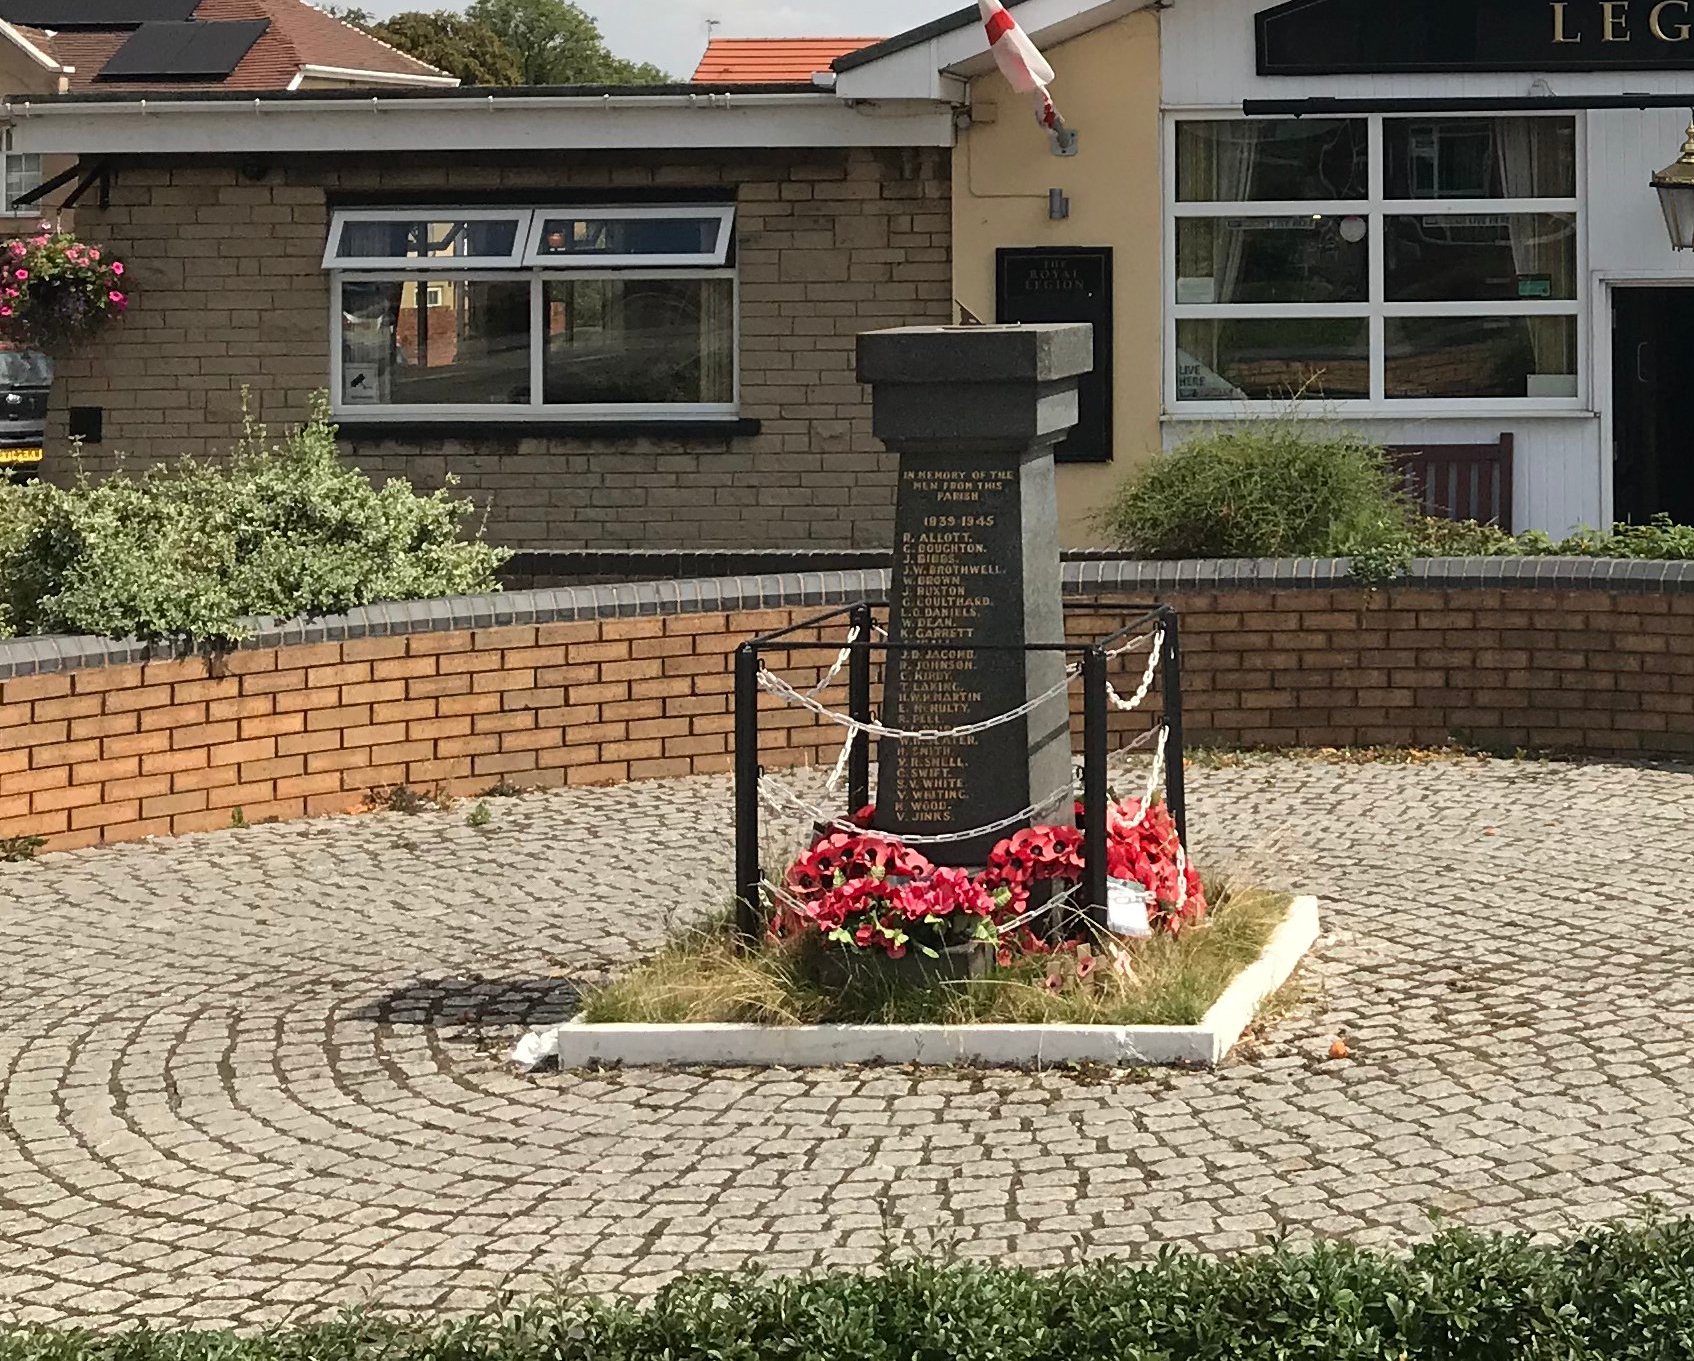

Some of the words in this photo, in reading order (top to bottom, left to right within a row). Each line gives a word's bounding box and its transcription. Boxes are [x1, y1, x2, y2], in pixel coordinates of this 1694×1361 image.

[903, 471, 915, 479] IN
[918, 471, 966, 479] MEMORY
[971, 471, 987, 479] OF
[990, 471, 1015, 479] THE
[913, 481, 938, 490] MEN
[943, 481, 973, 490] FROM
[977, 481, 1003, 490] THIS
